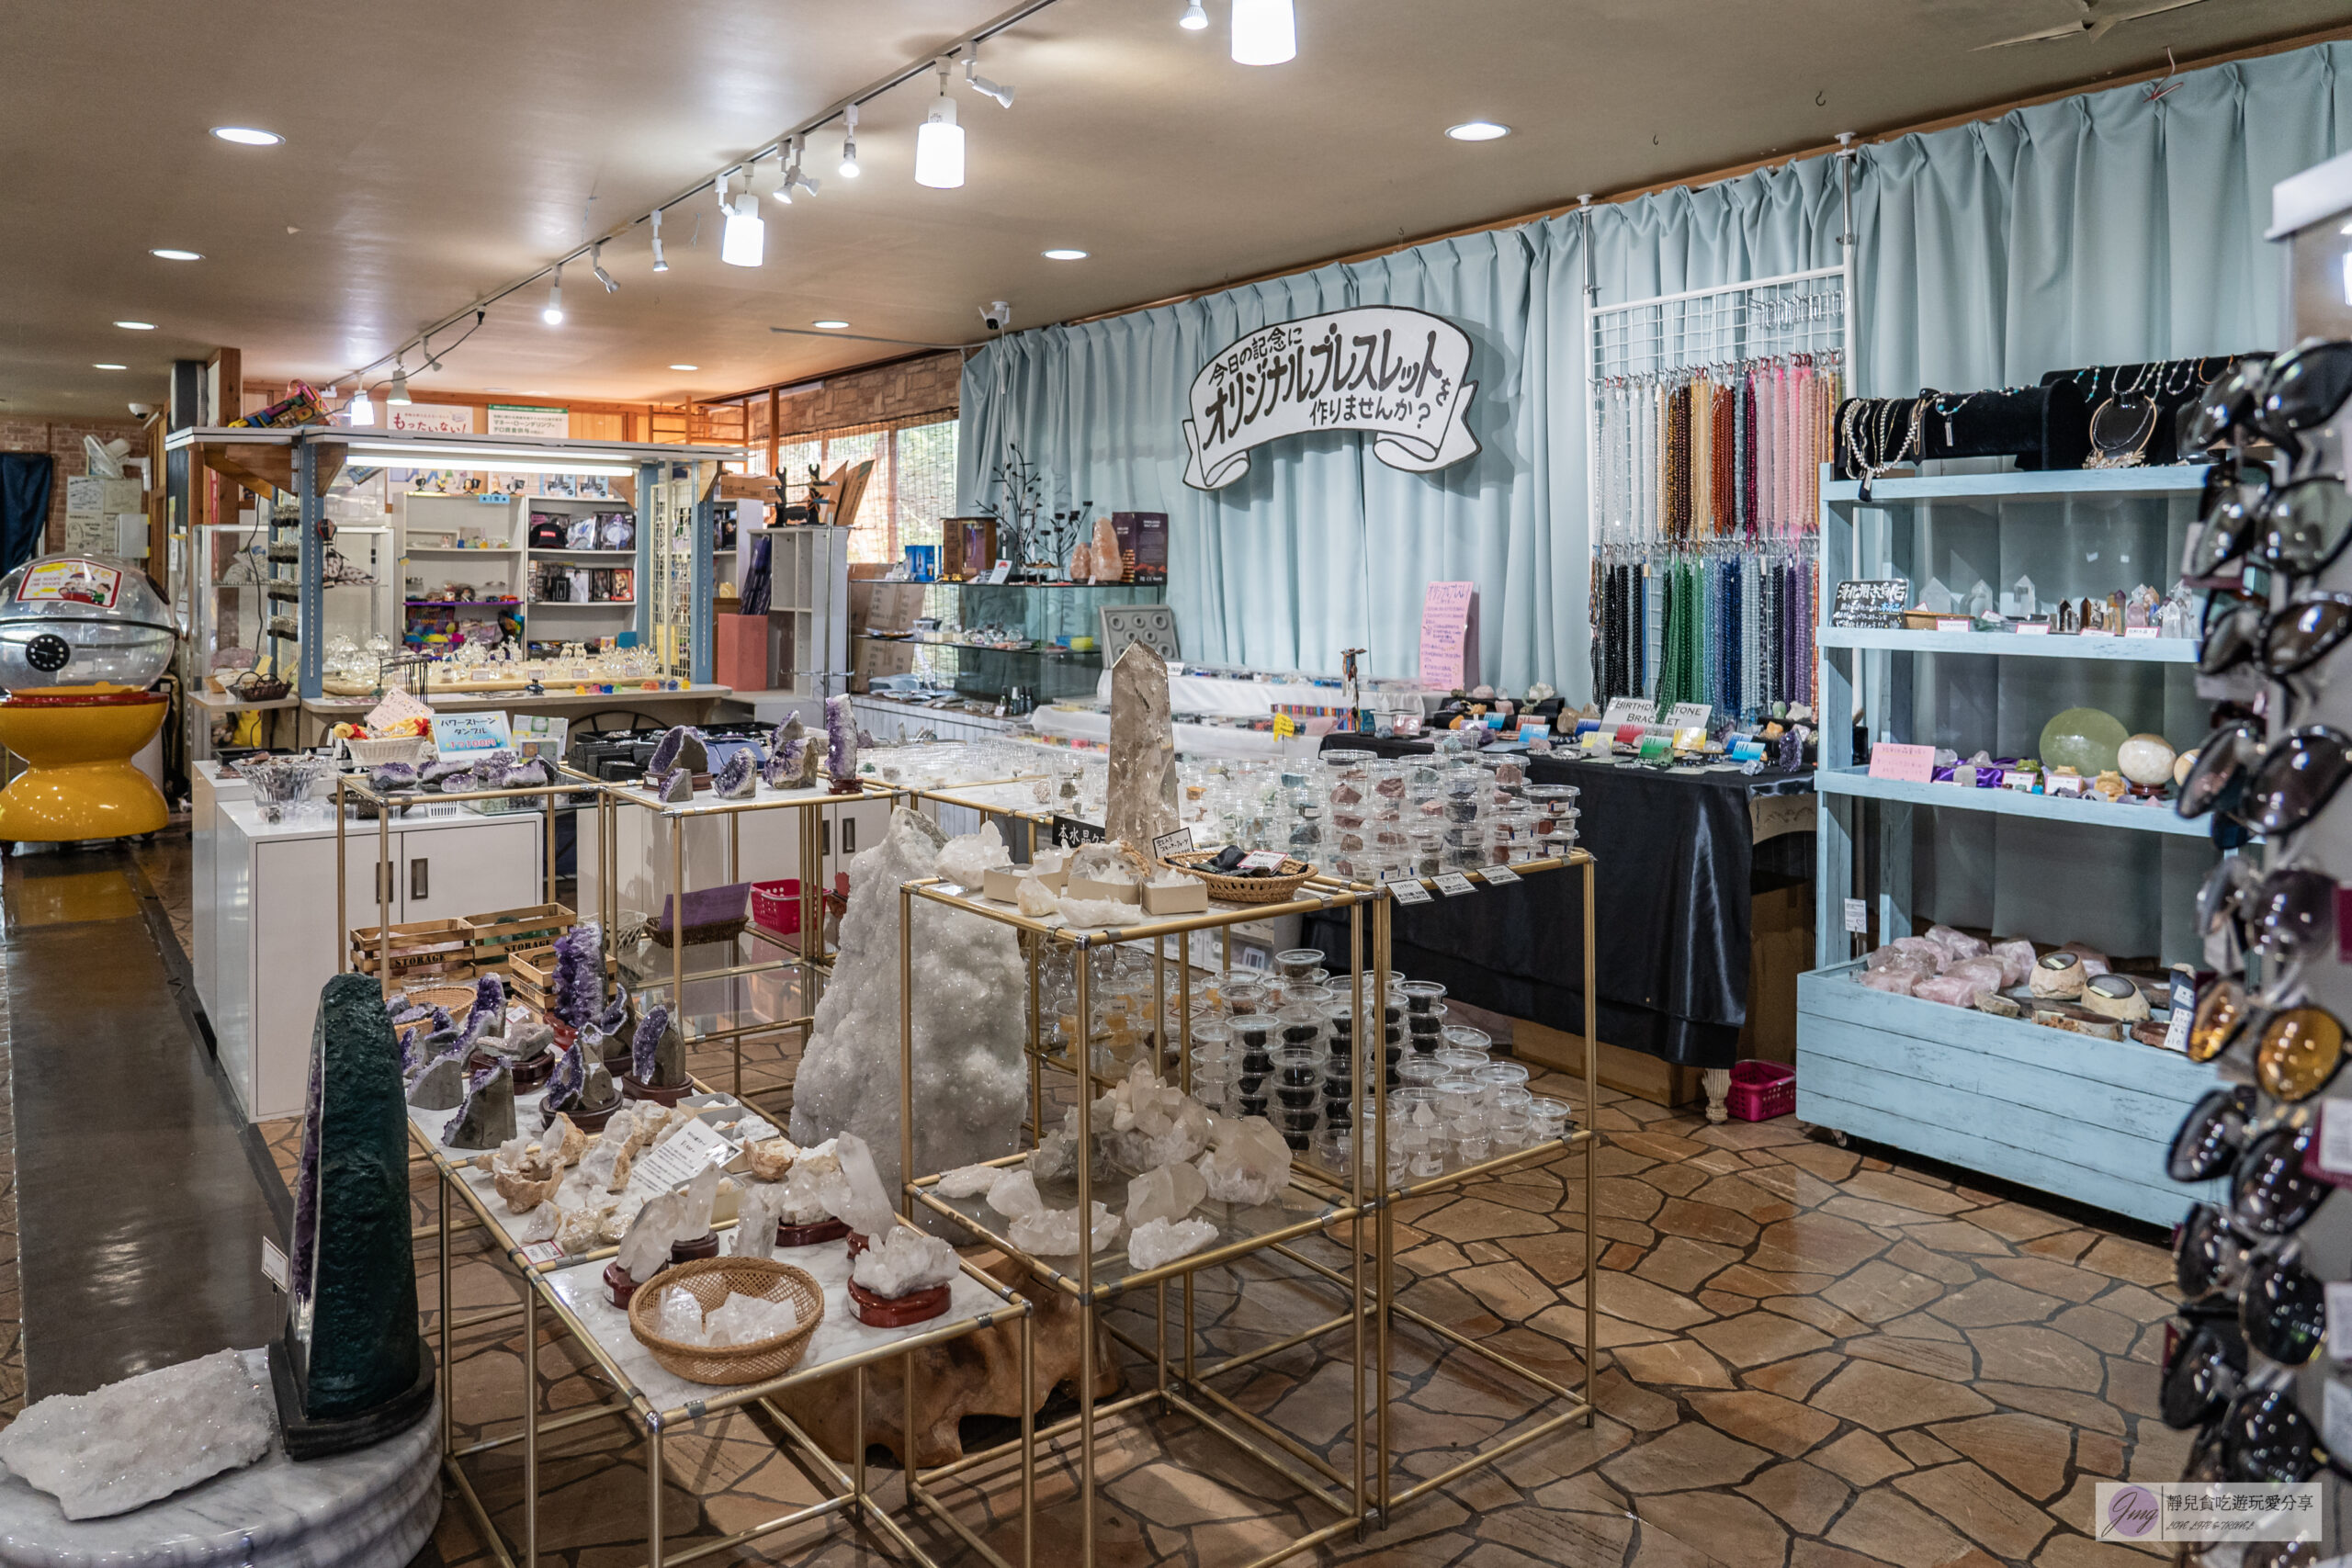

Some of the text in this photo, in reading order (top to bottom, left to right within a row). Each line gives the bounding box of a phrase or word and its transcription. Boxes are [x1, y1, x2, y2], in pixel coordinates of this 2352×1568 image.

[1208, 326, 1303, 386] 今日の記念に
[1203, 322, 1452, 450] オリジナルブレスレットを
[1309, 395, 1431, 429] 作りませんか?
[440, 717, 497, 728] パワーストーン
[504, 939, 552, 953] STORAGE
[395, 953, 447, 967] STORAGE
